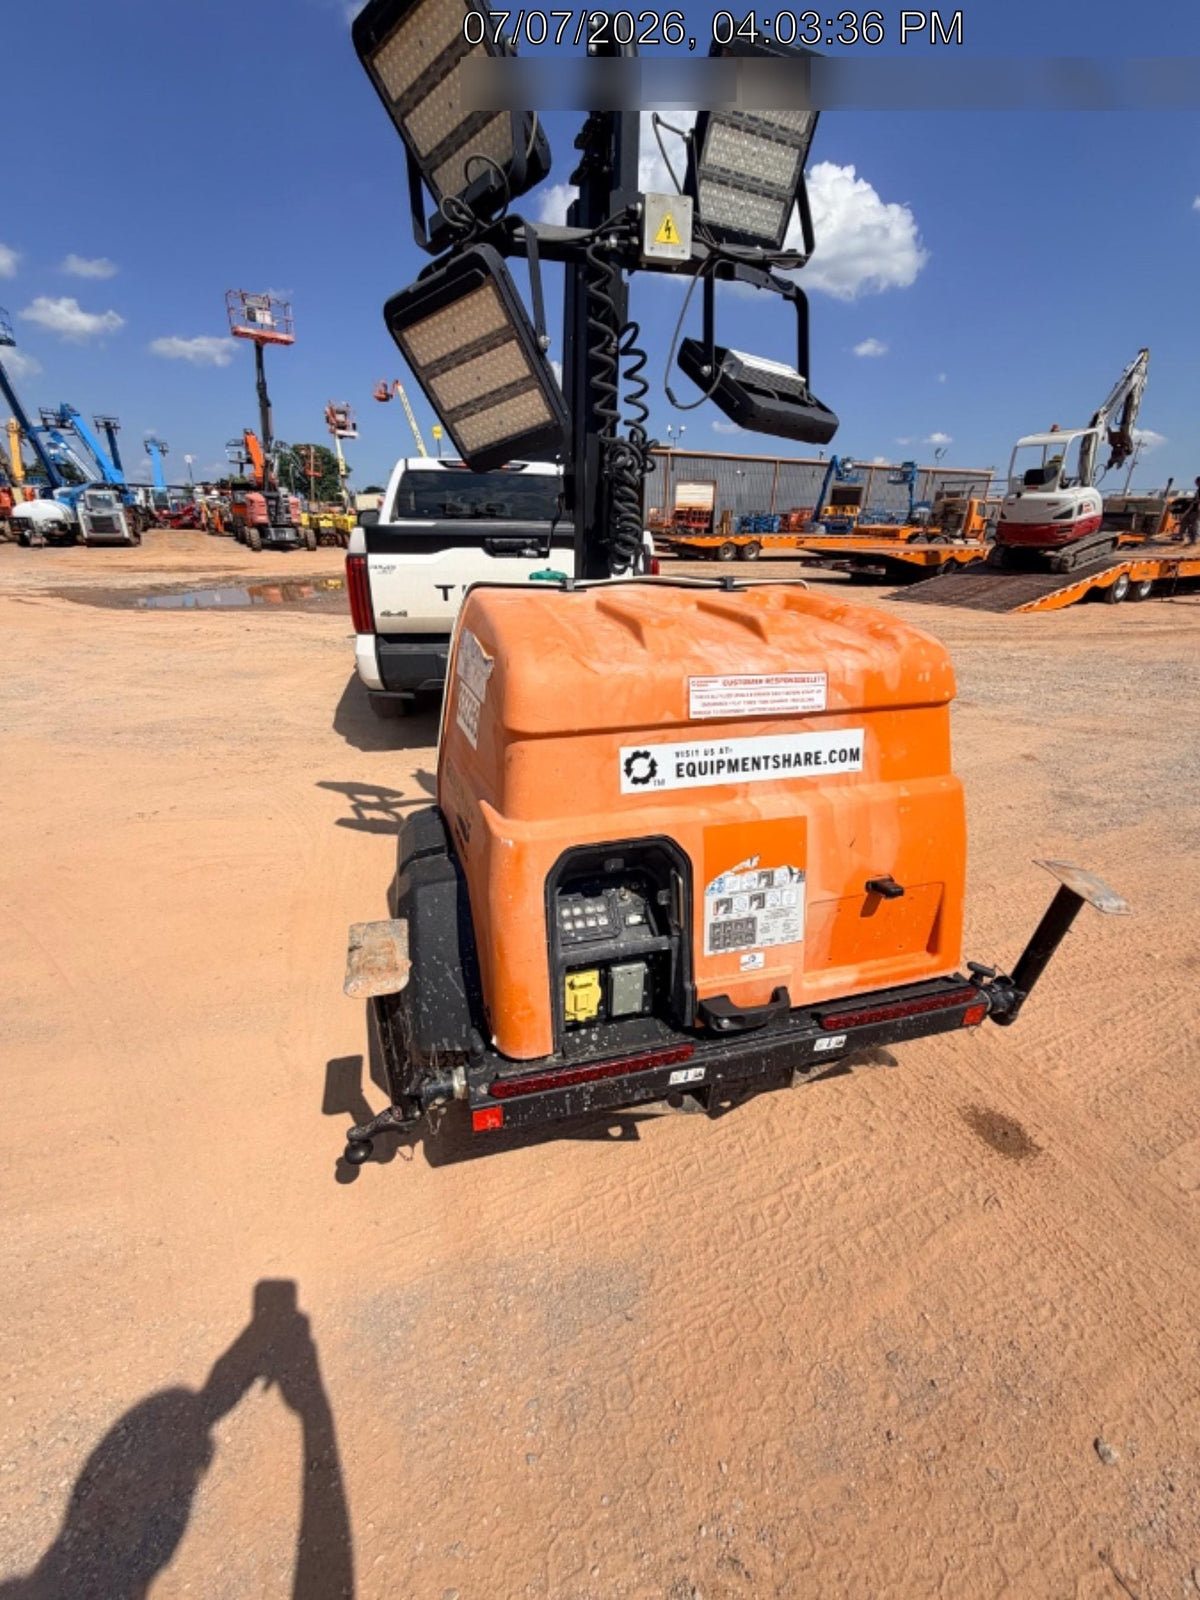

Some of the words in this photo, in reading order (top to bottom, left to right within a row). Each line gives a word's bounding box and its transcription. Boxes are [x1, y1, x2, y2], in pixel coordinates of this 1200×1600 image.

[675, 749, 699, 758] VISIT
[704, 747, 715, 756] US
[676, 747, 860, 778] EQUIPMENTSHARE.COM
